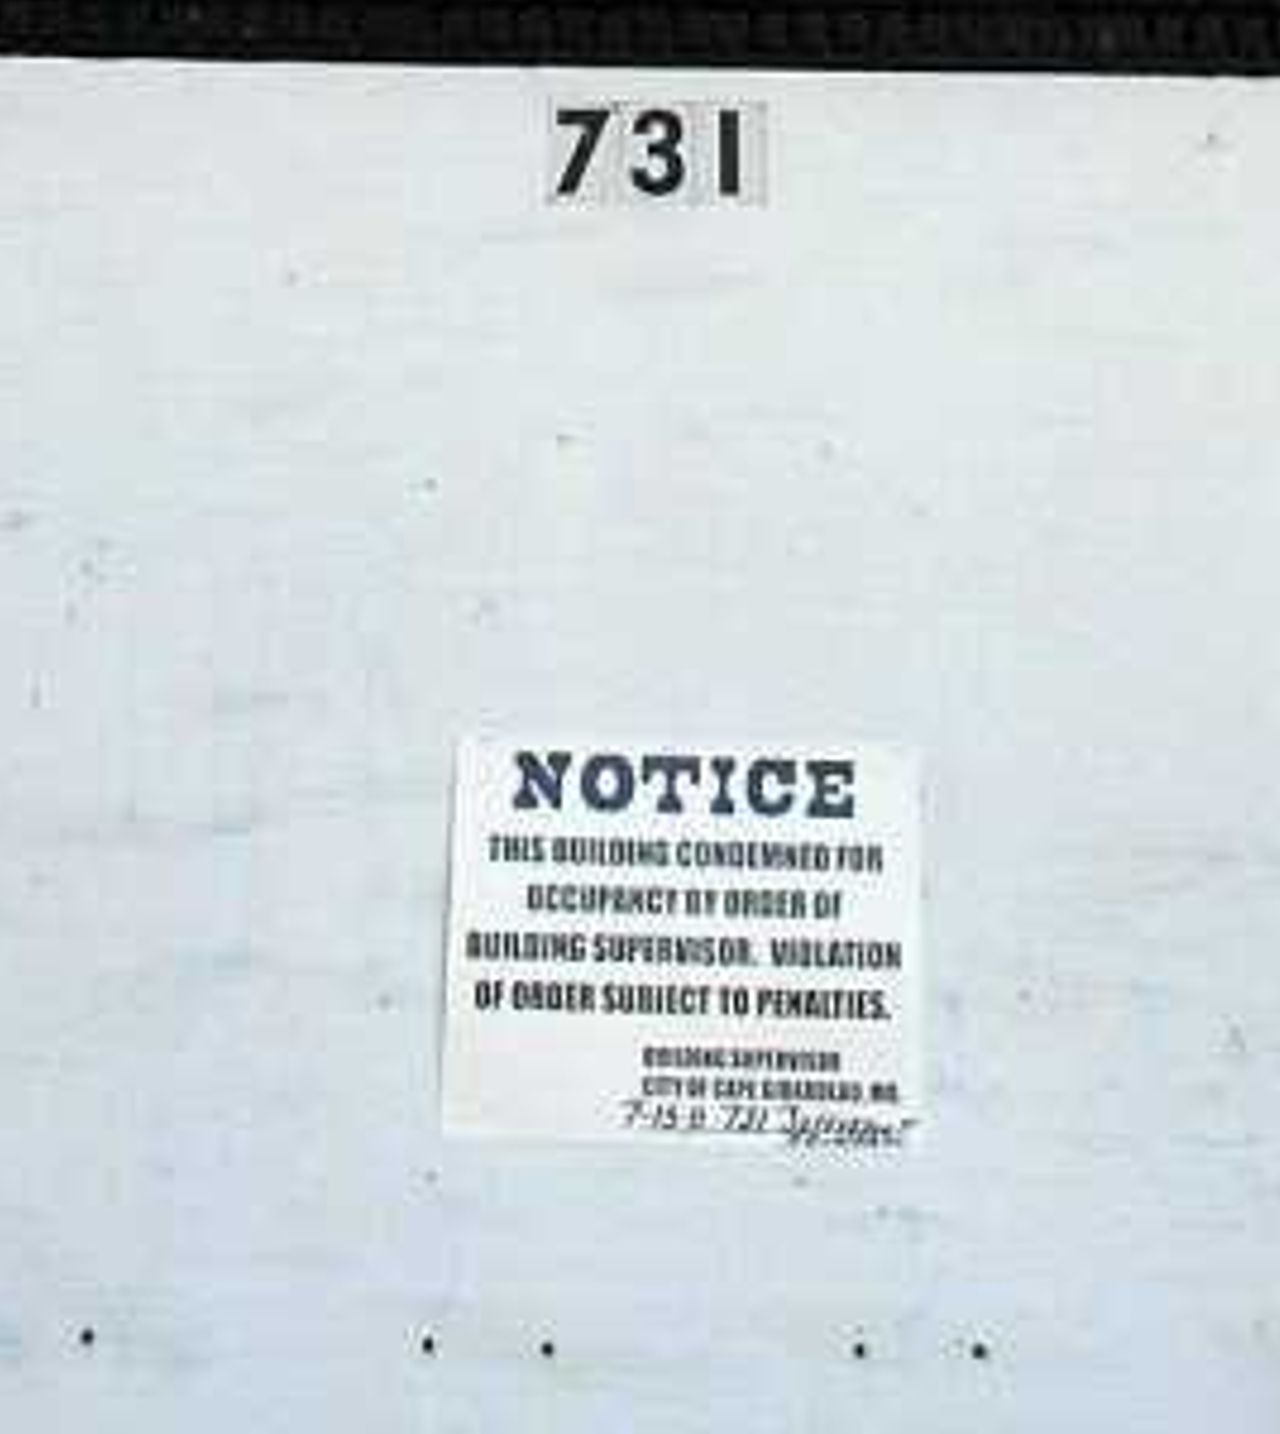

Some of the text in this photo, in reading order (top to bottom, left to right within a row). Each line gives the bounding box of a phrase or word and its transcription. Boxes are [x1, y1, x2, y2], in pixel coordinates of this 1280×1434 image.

[556, 108, 740, 197] 731
[512, 750, 857, 819] NOTICE
[489, 835, 883, 874] THIS BUILDING CONDEMNED FOR
[527, 884, 841, 920] OCCUPANCY BY ORDER OF
[466, 931, 587, 963] BUILDING
[771, 938, 903, 971] VIOLATION
[475, 980, 893, 1021] OF ORDER SUBJECT TO PENALTIES.
[642, 1076, 682, 1099] CITY
